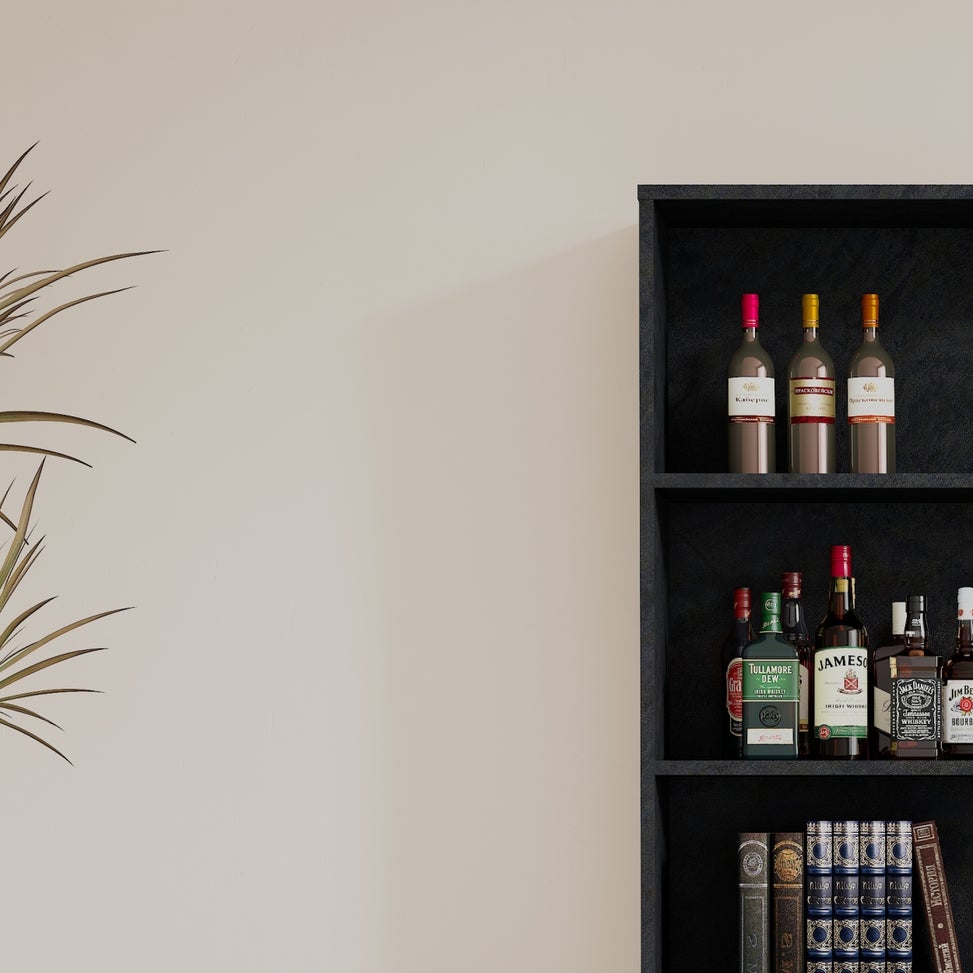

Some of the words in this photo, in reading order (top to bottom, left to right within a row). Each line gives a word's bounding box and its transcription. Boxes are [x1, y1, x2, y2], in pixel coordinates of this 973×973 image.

[749, 663, 792, 674] TULLAMORE
[762, 675, 779, 683] DEW
[948, 688, 963, 702] JIM
